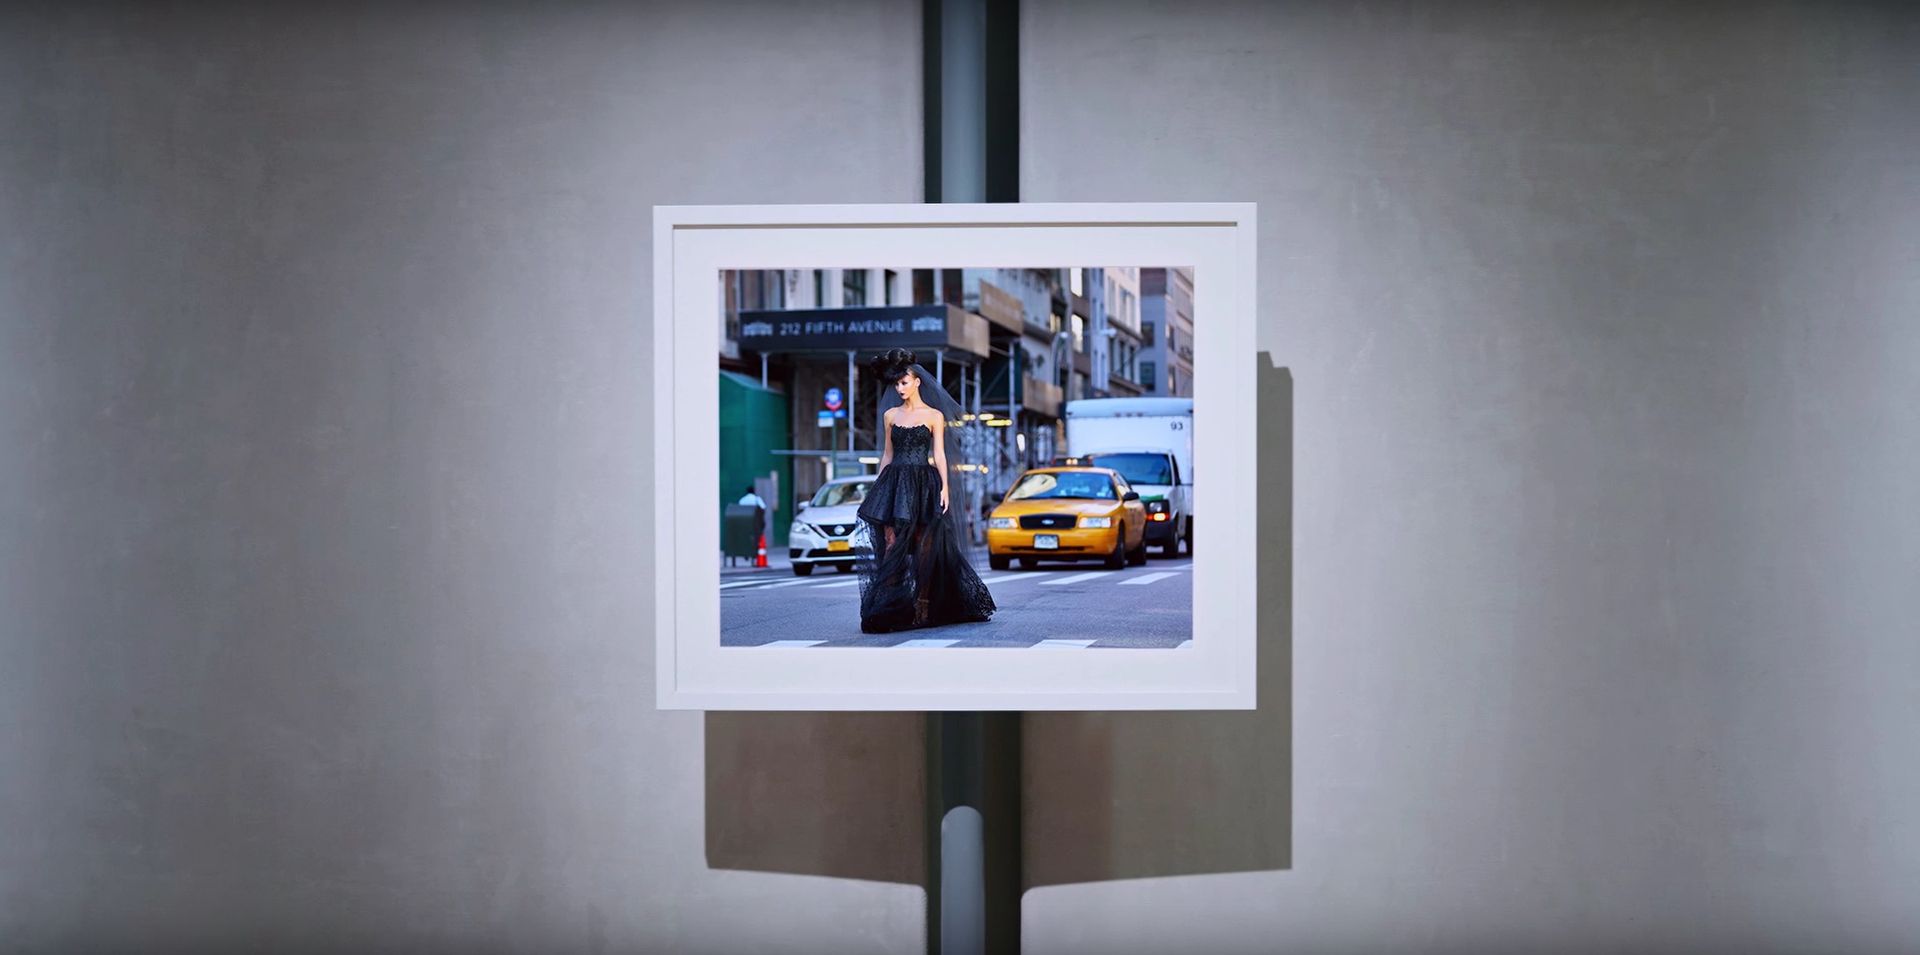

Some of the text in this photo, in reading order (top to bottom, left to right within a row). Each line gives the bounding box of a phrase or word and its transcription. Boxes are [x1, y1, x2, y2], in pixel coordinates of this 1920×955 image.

[780, 319, 904, 336] 212 FIFTH AVENUE
[1170, 421, 1183, 431] 93
